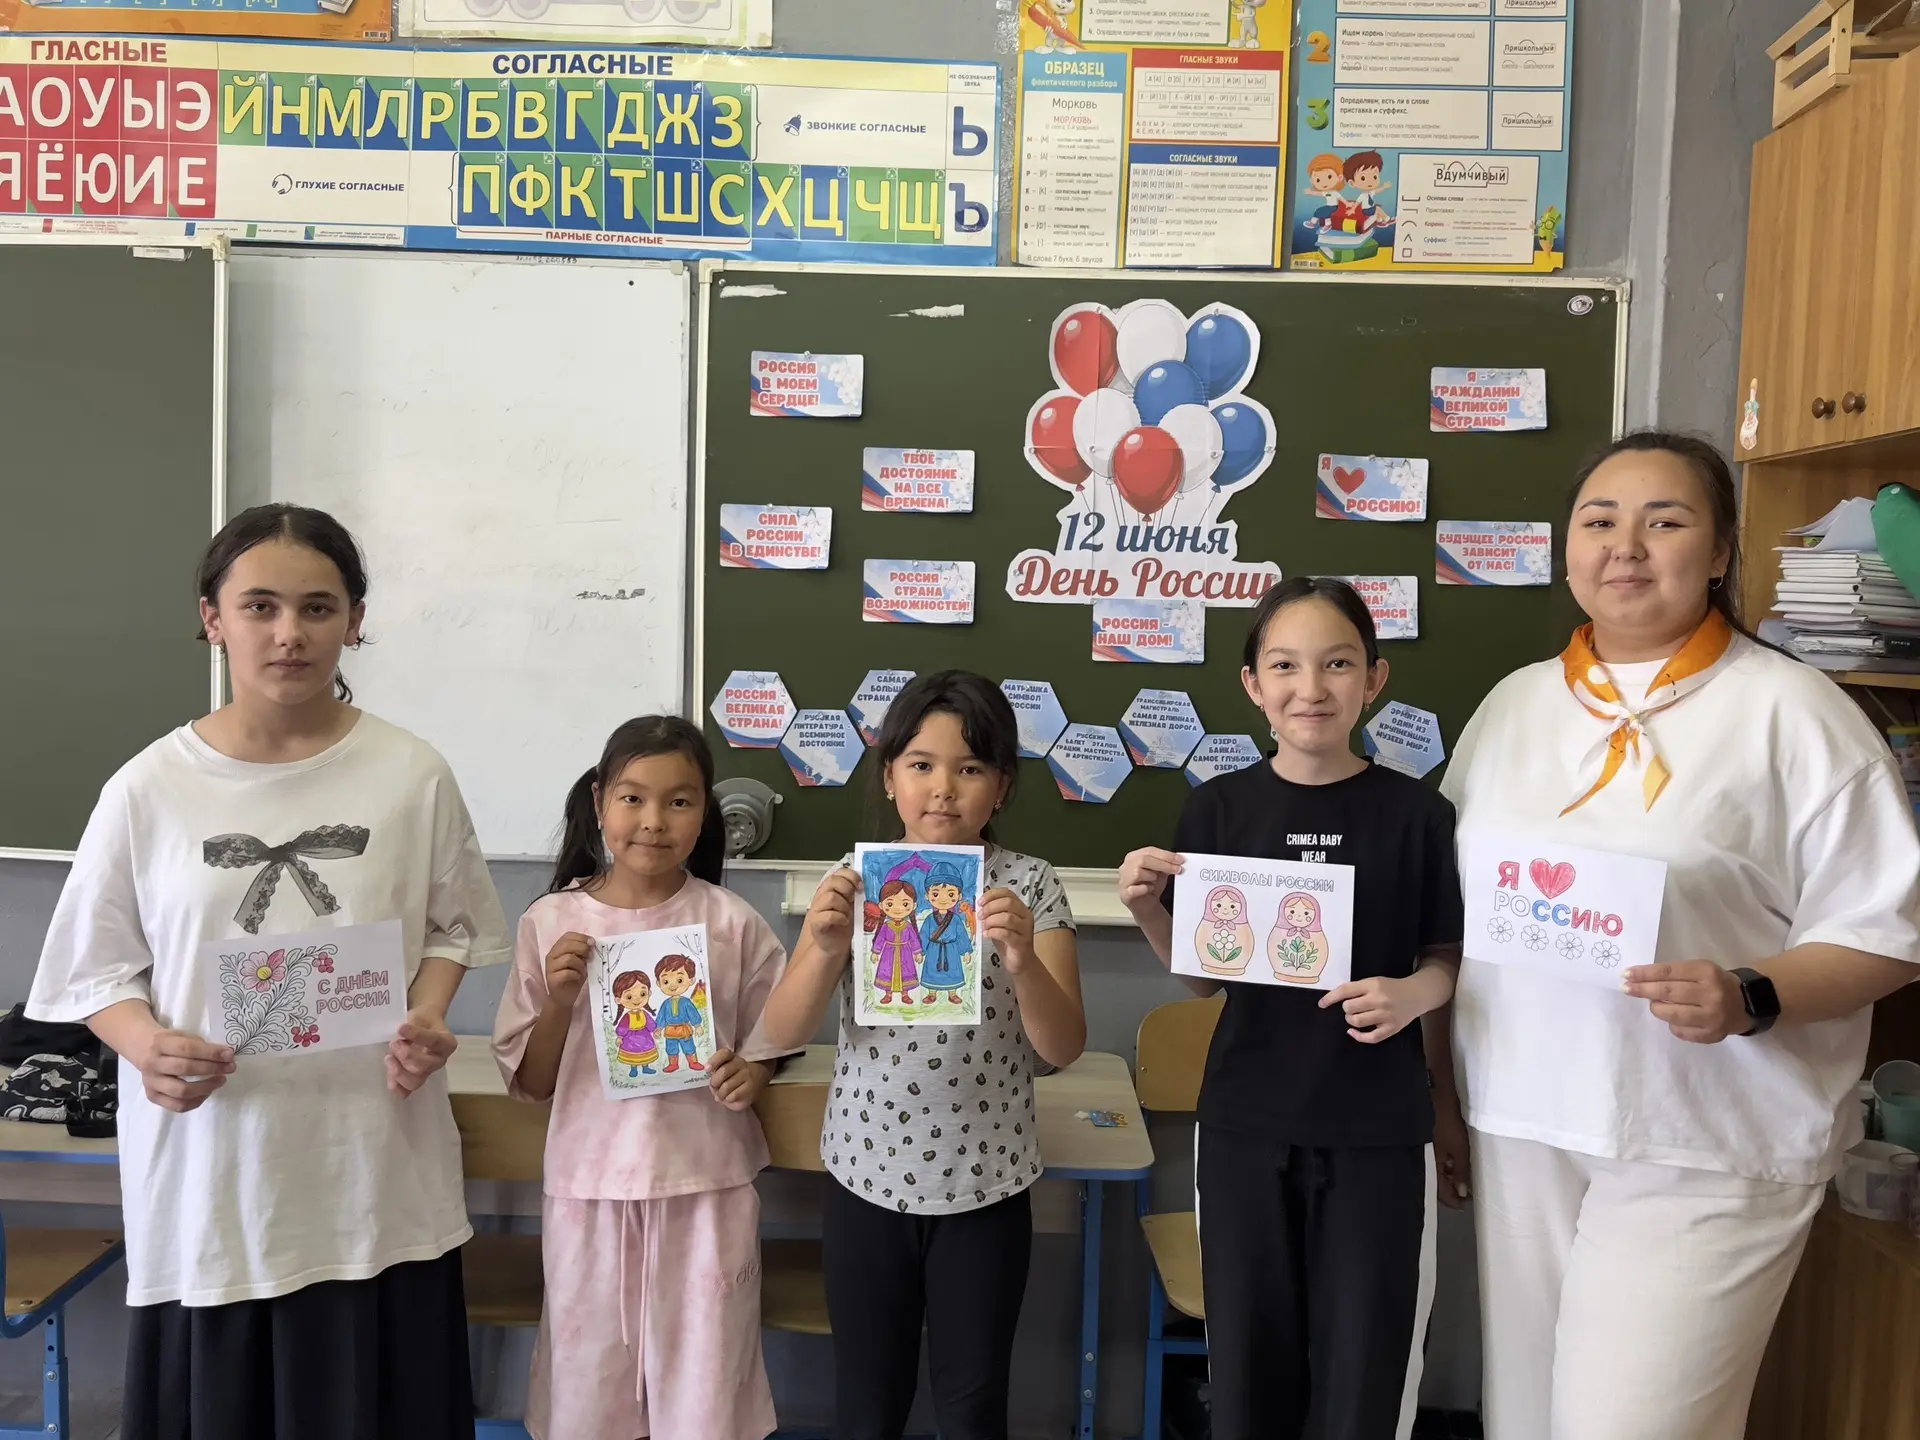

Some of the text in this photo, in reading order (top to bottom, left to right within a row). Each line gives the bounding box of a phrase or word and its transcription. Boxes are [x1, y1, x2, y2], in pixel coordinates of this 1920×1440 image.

[1342, 29, 1361, 37] Ищем
[31, 40, 168, 64] ГЛАСНЫЕ
[1306, 31, 1331, 64] 2
[1505, 44, 1554, 52] Пришкольный
[492, 54, 673, 76] СОГЛАСНЫЕ
[1180, 55, 1239, 64] ГЛАСНЫЕ ЗВУКИ
[1044, 61, 1105, 77] ОБРАЗЕЦ
[1087, 80, 1118, 88] разбора
[1052, 98, 1098, 110] Морковь
[1306, 98, 1330, 130] 3
[807, 121, 927, 135] ЗВОНКИЕ СОГЛАСНЫЕ
[1169, 154, 1238, 164] СОГЛАСНЫЕ ЗВУКИ
[1437, 169, 1506, 182] Вдумчивый
[295, 180, 405, 193] ГЛУХИЕ СОГЛАСНЫЕ
[544, 231, 664, 245] ПАРНЫЕ СОГЛАСНЫЕ
[758, 360, 817, 374] РОССИЯ
[762, 377, 818, 390] В МОЕМ
[1467, 372, 1477, 383] Я
[1434, 385, 1520, 397] ГРАЖДАНИН
[759, 393, 820, 407] СЕРДЦЕ!
[1445, 400, 1508, 412] ВЕЛИКОЙ
[1446, 416, 1506, 427] СТРАНЫ
[1321, 457, 1331, 470] Я
[879, 467, 957, 479] ДОСТОЯНИЕ
[894, 482, 942, 494] НА ВСЕ
[885, 497, 949, 509] ВРЕМЕНА!
[1346, 499, 1421, 513] РОССИЮ!
[758, 513, 797, 525] СИЛА
[746, 529, 803, 541] РОССИИ
[1064, 511, 1230, 555] 12 июня
[1438, 533, 1547, 545] БУДУЩЕЕ РОССИИ
[731, 544, 821, 559] В ЕДИНСТВЕ!
[1462, 547, 1517, 557] ЗАВИСИТ
[1467, 560, 1515, 570] ОТ НАС!
[890, 572, 939, 584] РОССИЯ
[1015, 555, 1274, 600] День России
[894, 586, 943, 597] СТРАНА
[866, 599, 970, 611] ВОЗМОЖНОСТЕЙ!
[1102, 617, 1159, 630] РОССИЯ
[1097, 633, 1173, 647] НАШ ДОМ!
[725, 688, 776, 700] РОССИЯ
[857, 693, 891, 702] СТРАНА
[1008, 693, 1041, 702] СИМВОЛ
[726, 703, 785, 715] ВЕЛИКАЯ
[1160, 715, 1195, 723] ДЛИННАЯ
[1390, 707, 1431, 726] ЭРМИТАЖ
[728, 717, 782, 729] СТРАНА!
[1128, 720, 1197, 731] ЖЕЛЕЗНАЯ ДОРОГА
[1391, 717, 1427, 733] ОДИН ИЗ
[799, 740, 845, 748] ДОСТОЯНИЕ
[1375, 730, 1429, 753] МУЗЕЕВ МИРА
[1286, 834, 1343, 846] CRIMEA BABY
[1301, 851, 1326, 863] WEAR
[1199, 869, 1335, 892] СИМВОЛЫ РОССИИ
[1497, 860, 1521, 890] Я
[1493, 890, 1624, 937] РОССИЮ
[317, 970, 389, 995] С ДНЁМ
[316, 990, 390, 1015] РОССИИ
